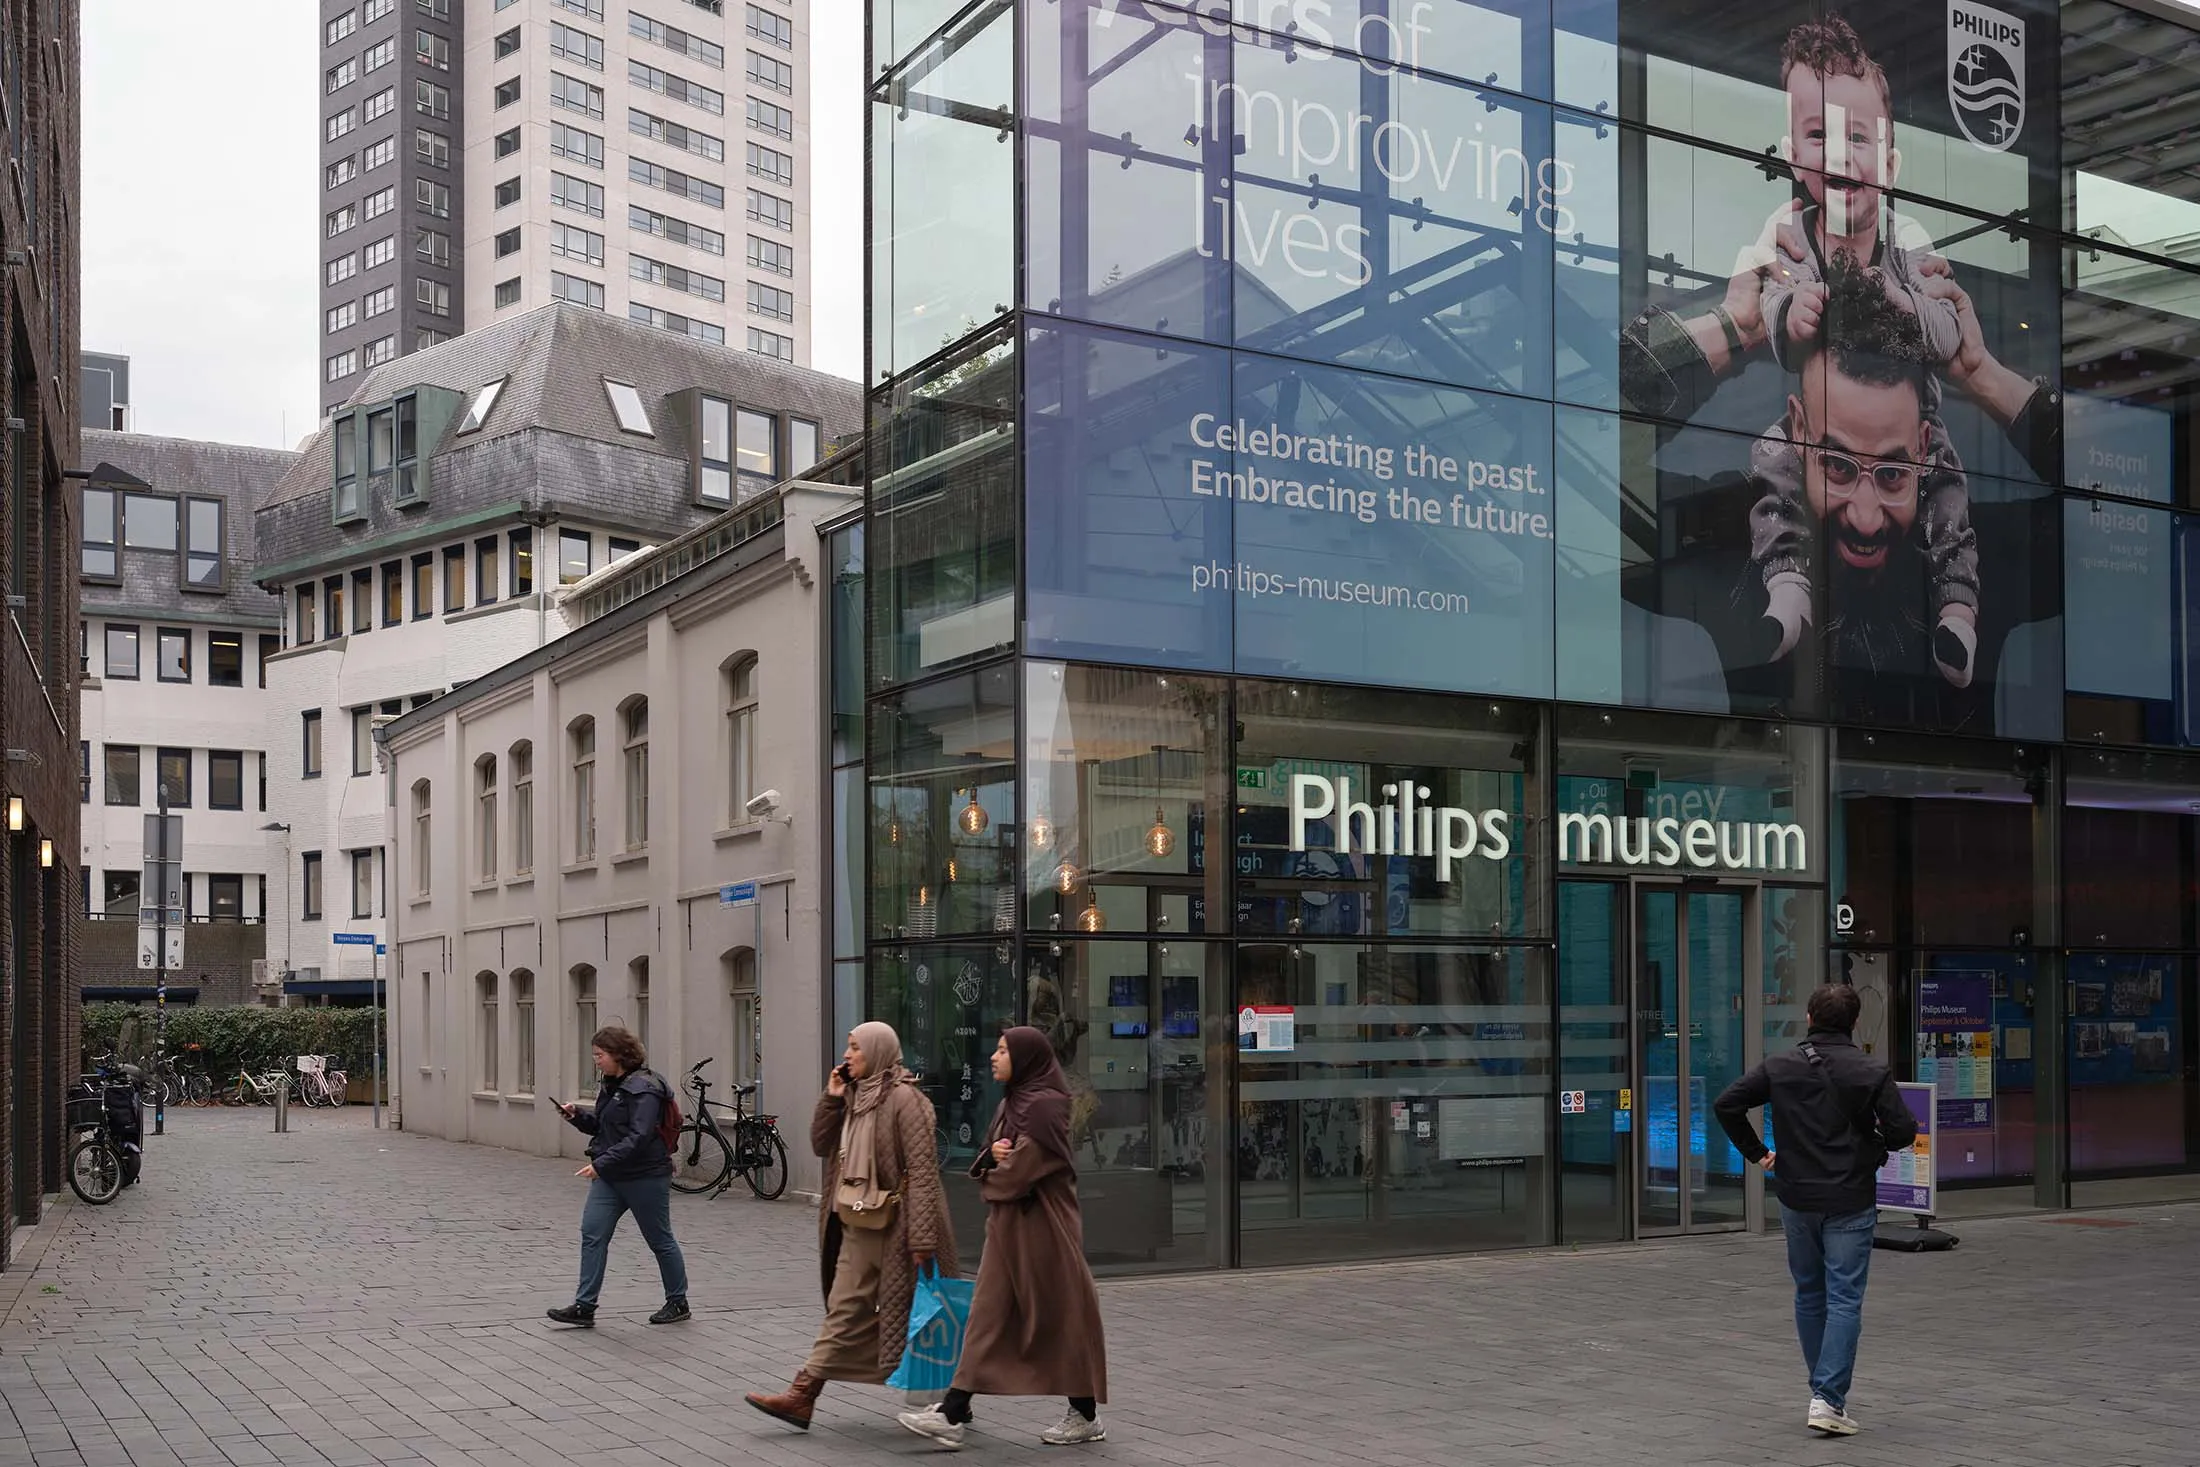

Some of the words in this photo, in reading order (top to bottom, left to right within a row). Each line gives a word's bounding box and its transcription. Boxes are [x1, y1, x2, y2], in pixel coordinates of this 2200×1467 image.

[1095, 0, 1334, 61] ars
[1354, 0, 1440, 84] of
[1953, 9, 2021, 48] PHILIPS
[1186, 54, 1575, 236] improving
[1195, 168, 1373, 286] lives
[1190, 413, 1394, 480] Celebrating
[1404, 444, 1458, 482] the
[1468, 459, 1546, 496] past.
[1191, 459, 1376, 523] Embracing
[1387, 486, 1442, 524] the
[1450, 494, 1555, 539] future.
[1192, 559, 1469, 614] phlips-museum.com
[1289, 774, 1509, 882] Philips
[1558, 812, 1806, 870] museum
[1941, 1005, 1967, 1014] Museum
